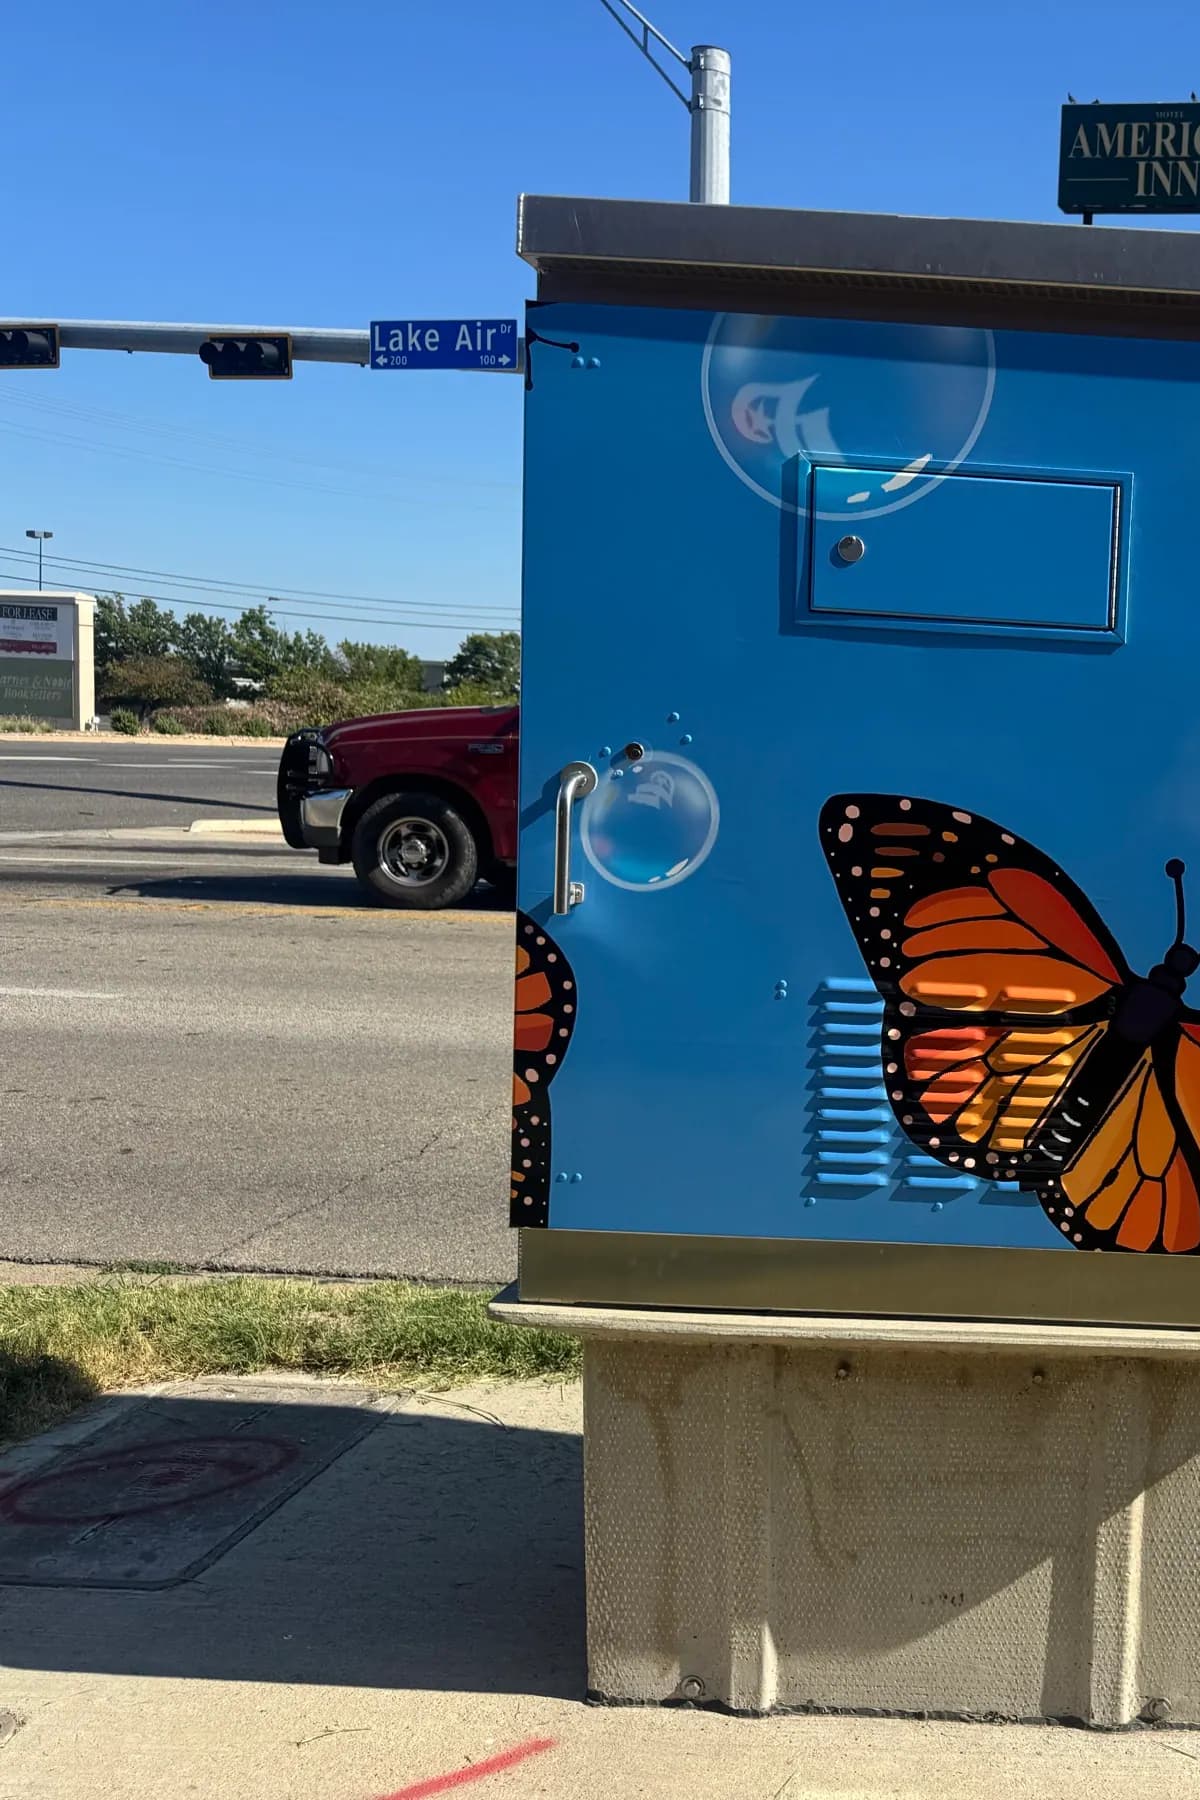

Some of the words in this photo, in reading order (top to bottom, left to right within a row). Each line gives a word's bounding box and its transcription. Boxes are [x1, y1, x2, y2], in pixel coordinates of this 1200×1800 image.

[1155, 111, 1184, 119] MOTEL
[1135, 160, 1200, 197] INN
[374, 323, 440, 352] Lake
[455, 321, 497, 352] Air
[500, 324, 512, 335] Dr
[390, 355, 408, 366] 200
[479, 354, 496, 366] 100
[2, 606, 22, 619] FOR
[23, 606, 54, 621] LEASE
